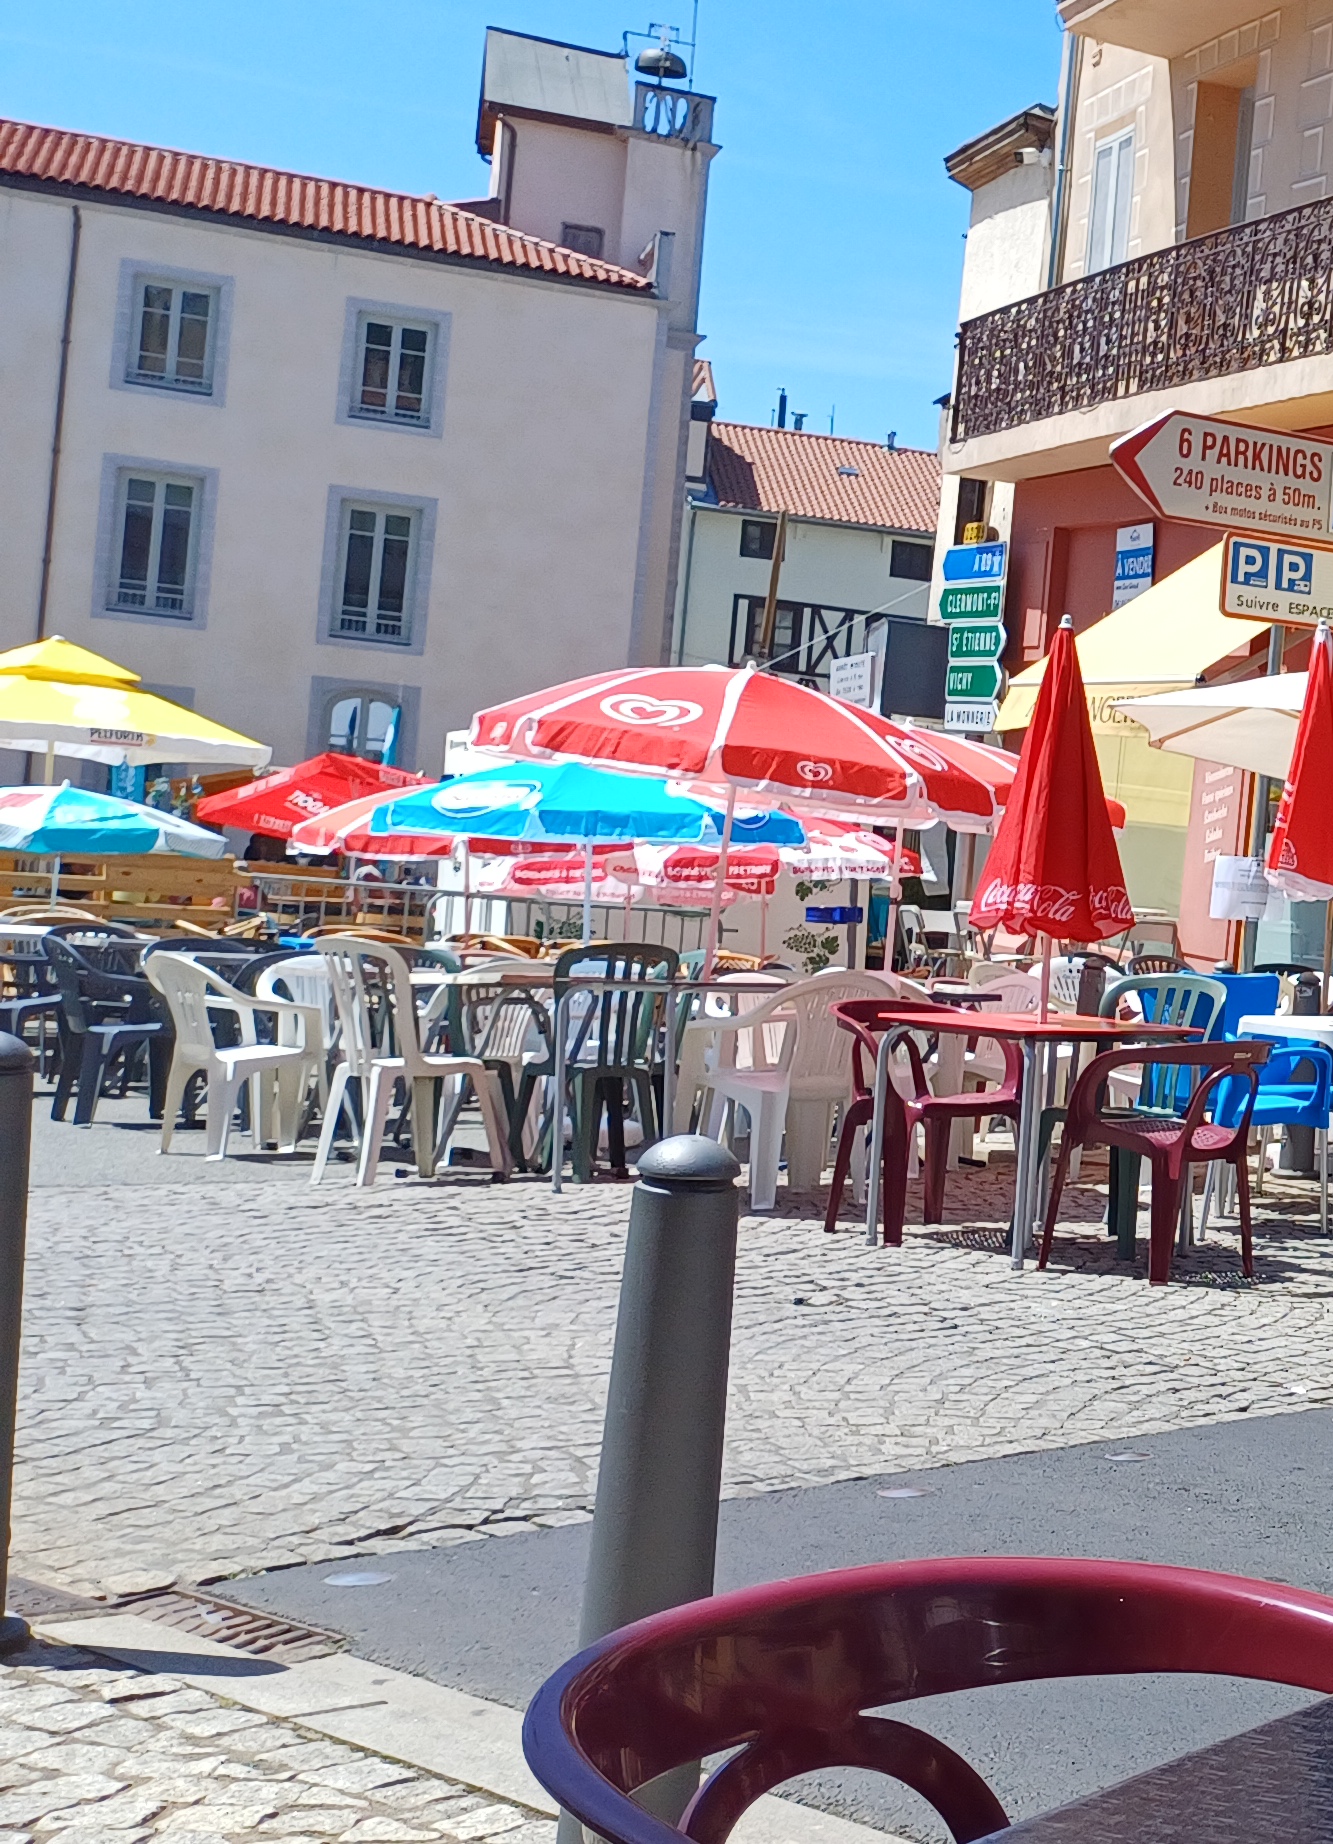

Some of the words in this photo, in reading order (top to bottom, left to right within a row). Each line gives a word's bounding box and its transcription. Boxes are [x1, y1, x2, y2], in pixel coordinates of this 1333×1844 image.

[1178, 427, 1193, 459] 6
[1201, 431, 1323, 483] PARKINGS
[1173, 466, 1205, 490] 240
[1208, 474, 1263, 501] places
[1267, 482, 1277, 503] à
[1236, 594, 1279, 612] Suivre
[1288, 601, 1333, 620] ESPACE
[949, 672, 973, 691] VICHY
